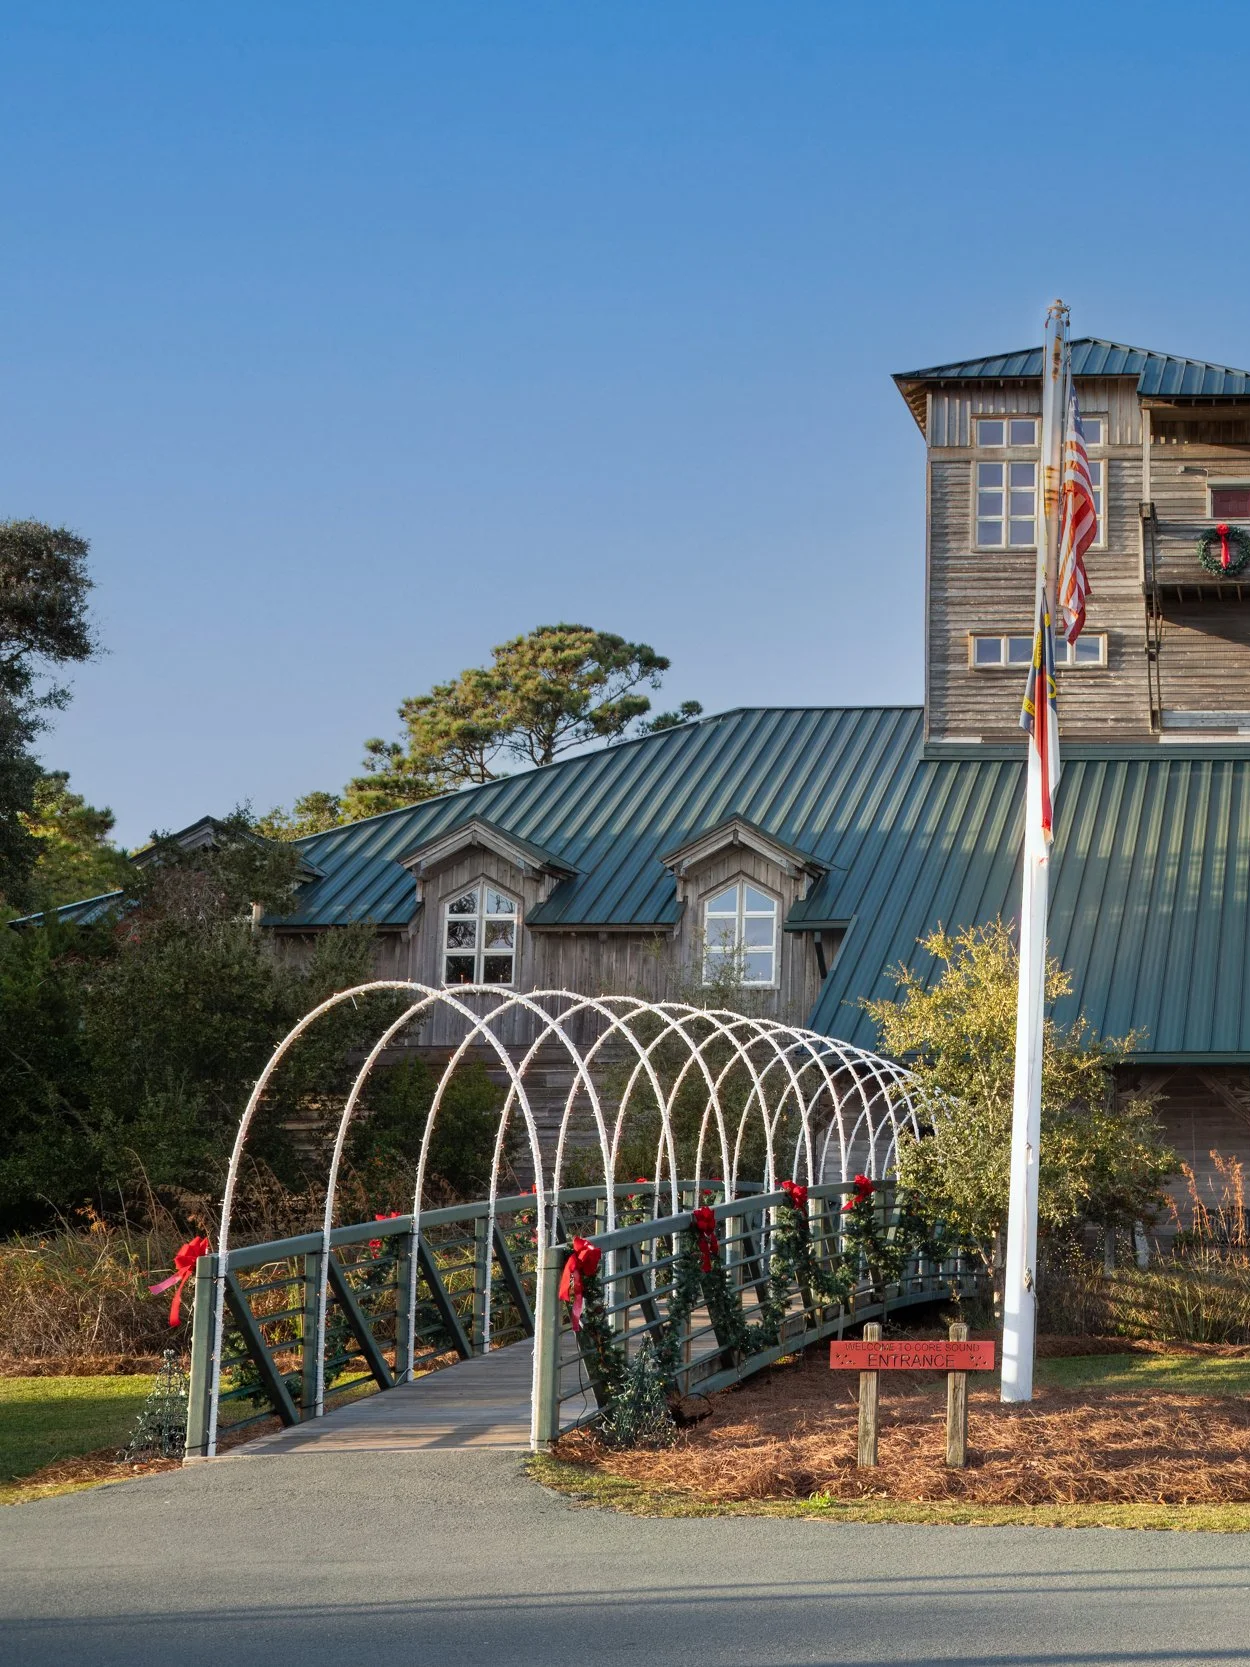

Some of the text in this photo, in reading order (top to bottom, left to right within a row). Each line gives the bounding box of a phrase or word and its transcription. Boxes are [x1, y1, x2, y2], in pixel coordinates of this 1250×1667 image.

[845, 1343, 980, 1352] WELCOME TO CORE SOUND
[868, 1354, 955, 1368] ENTRANCE
